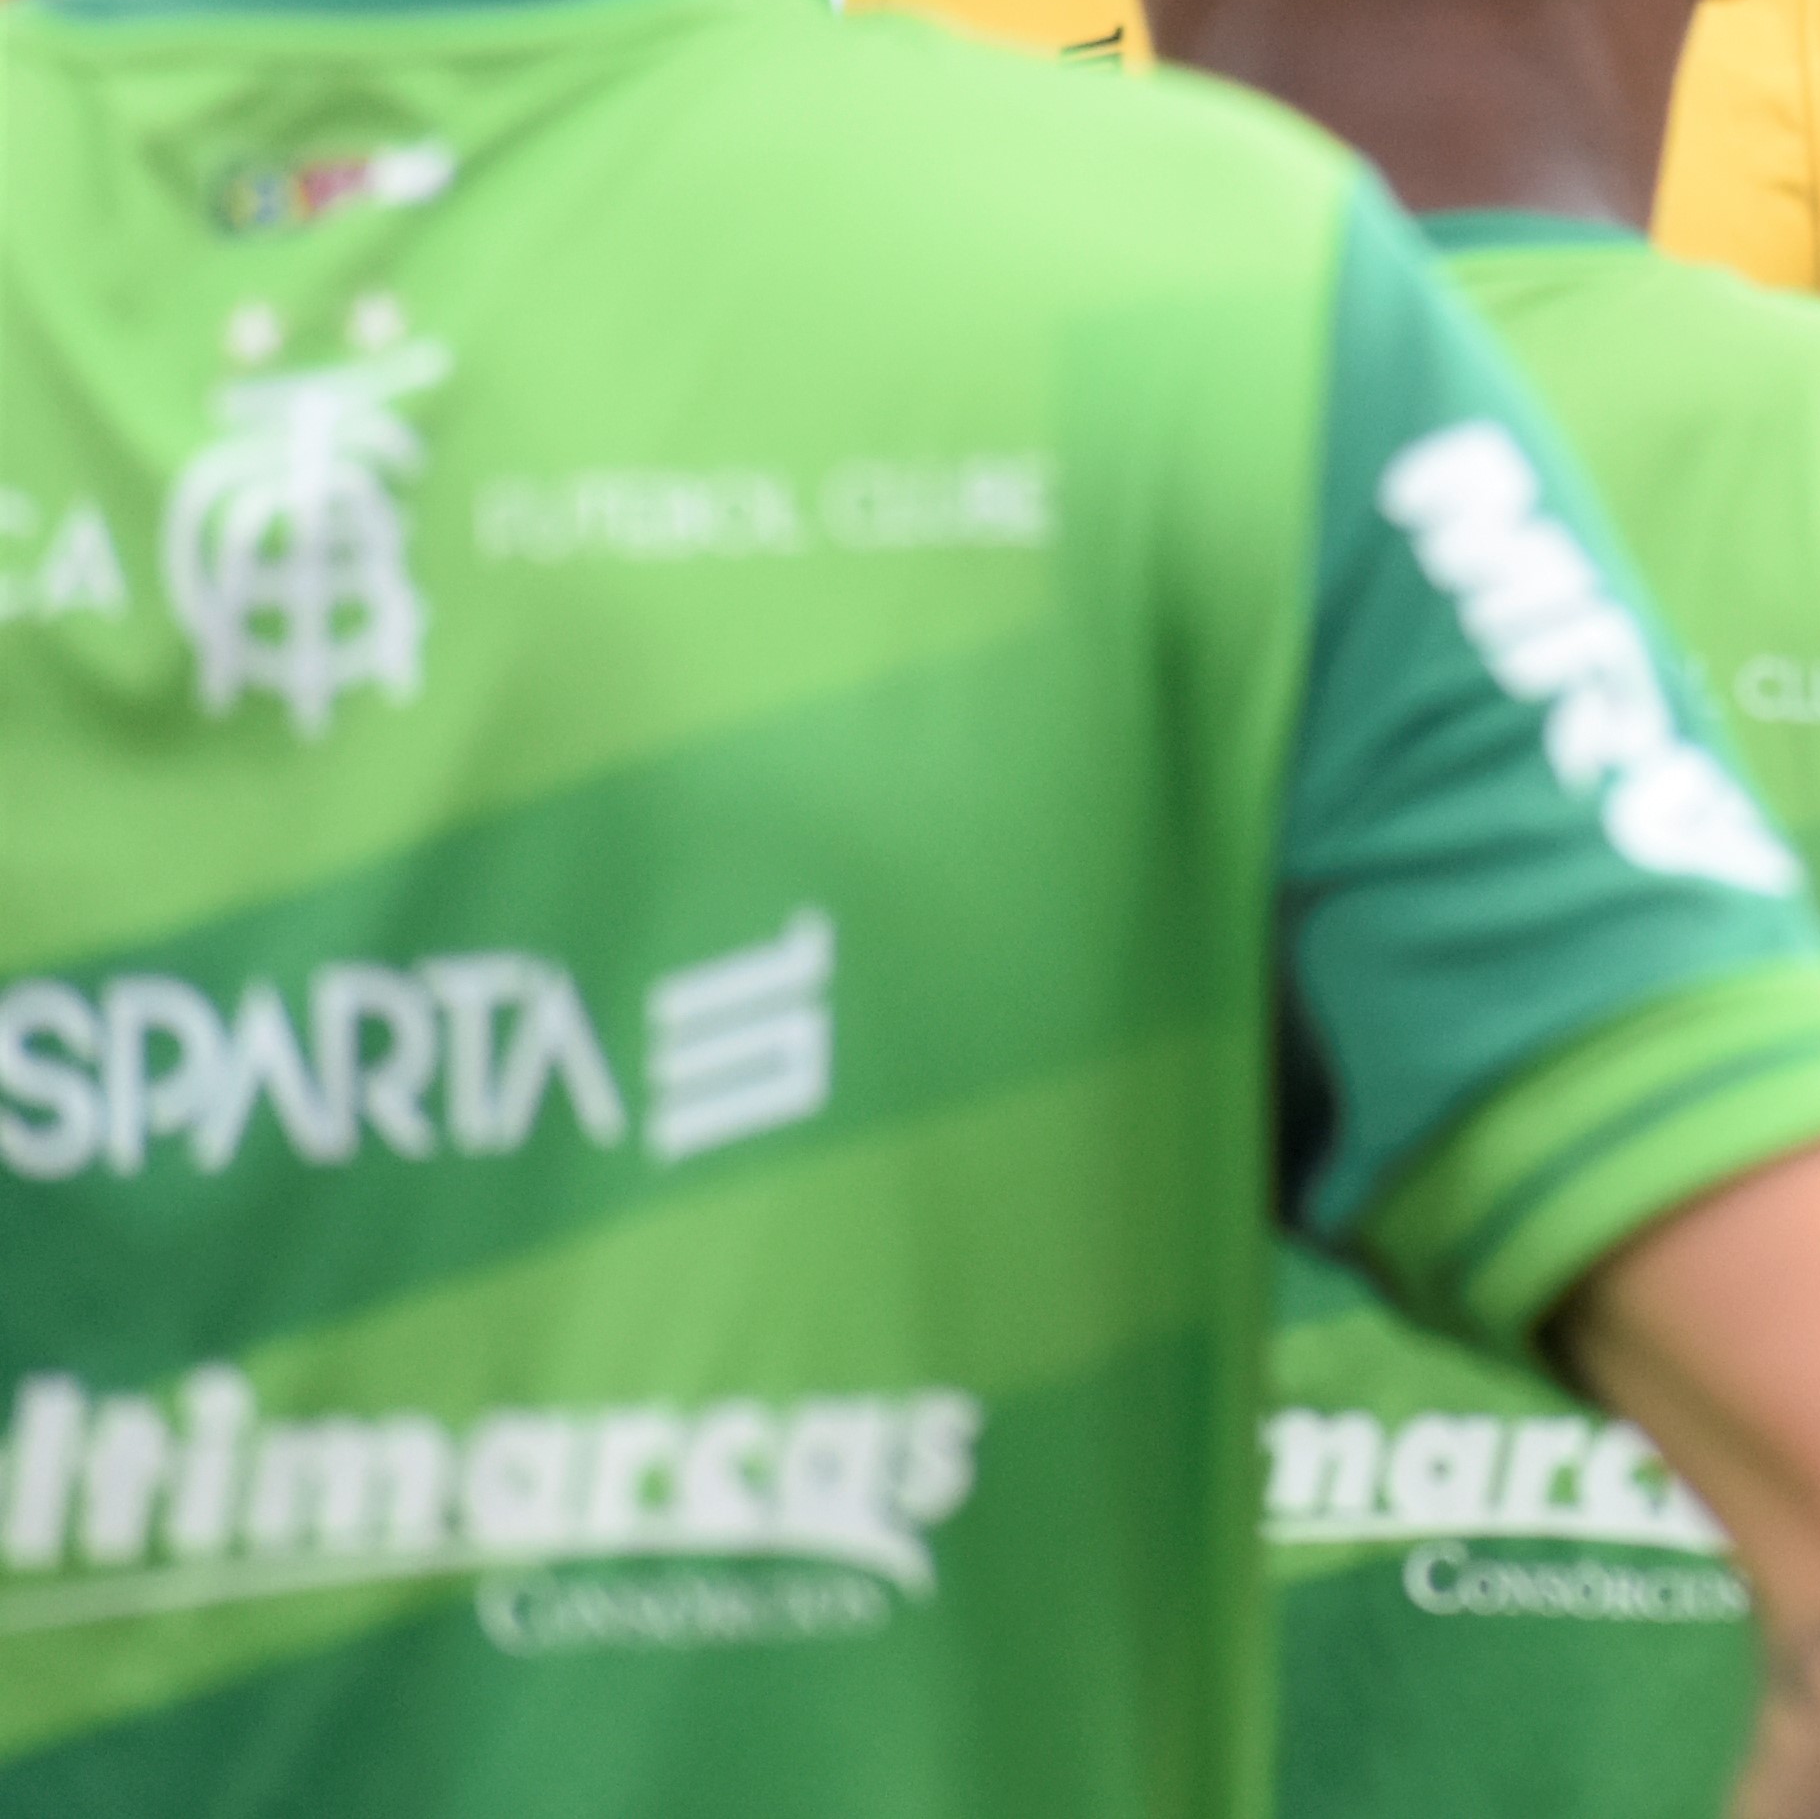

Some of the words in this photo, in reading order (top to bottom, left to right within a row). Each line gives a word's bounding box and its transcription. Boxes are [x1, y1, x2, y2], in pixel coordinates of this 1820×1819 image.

[1370, 418, 1798, 896] MRV
[0, 950, 628, 1180] SPARTA
[0, 1365, 980, 1580] ltimarcas
